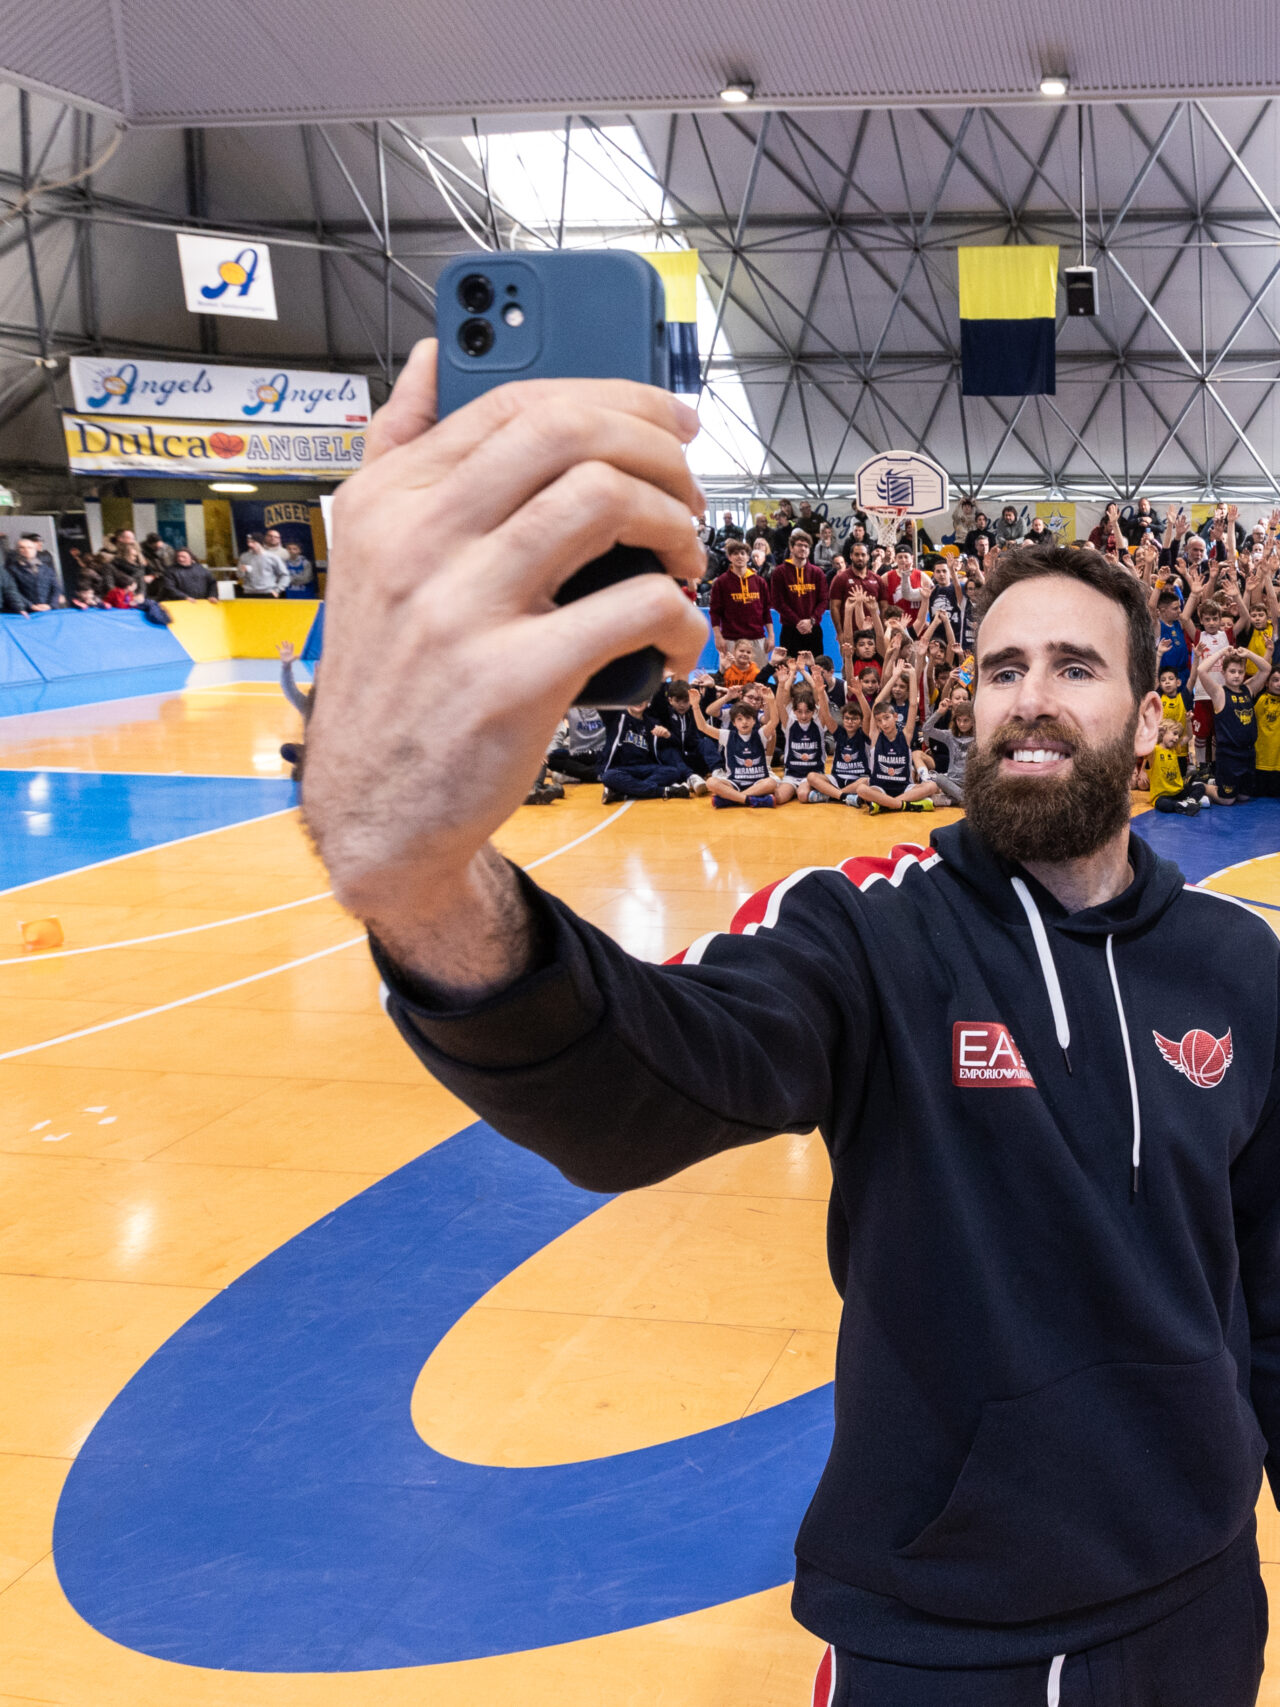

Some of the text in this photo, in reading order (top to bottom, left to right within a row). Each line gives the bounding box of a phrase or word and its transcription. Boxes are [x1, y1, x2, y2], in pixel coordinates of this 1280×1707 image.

[86, 363, 356, 416] Angels Angels
[74, 422, 365, 461] Dulca ANGELS
[960, 1068, 1003, 1080] EMPORIO
